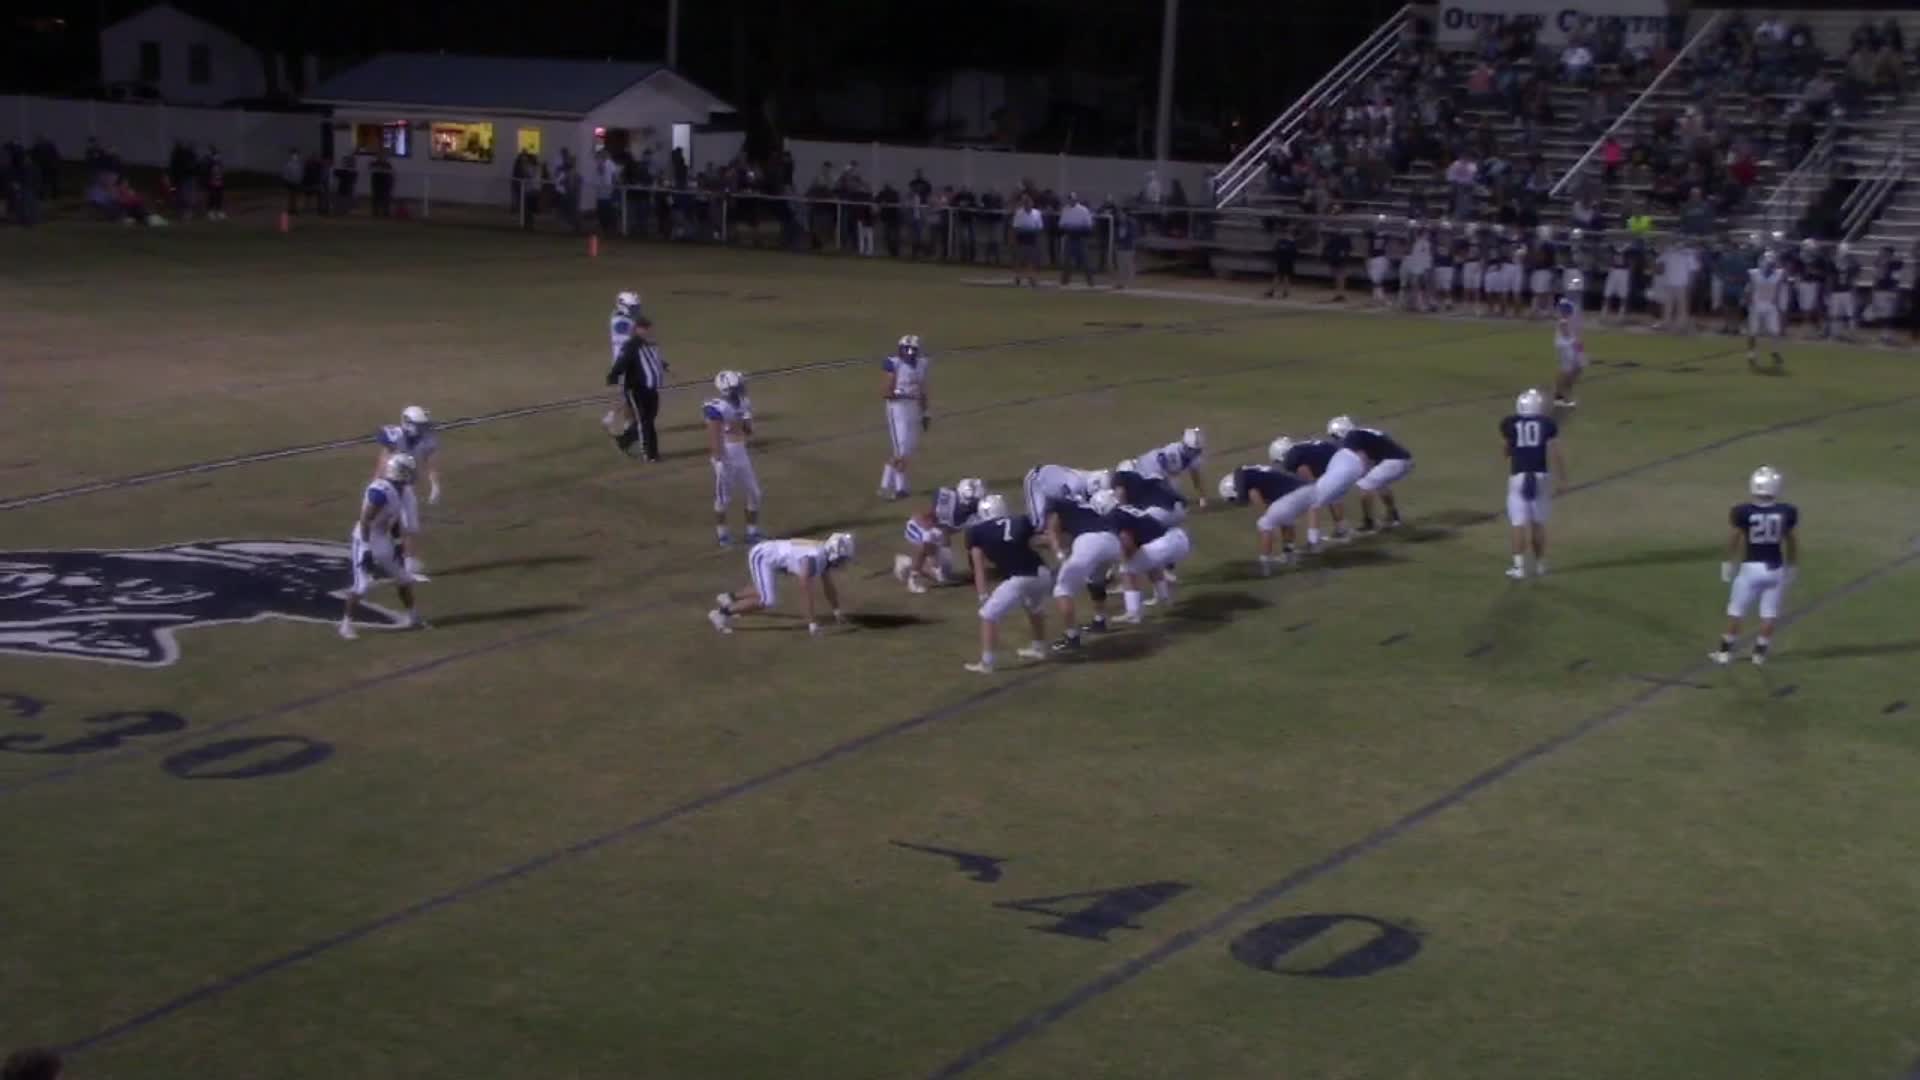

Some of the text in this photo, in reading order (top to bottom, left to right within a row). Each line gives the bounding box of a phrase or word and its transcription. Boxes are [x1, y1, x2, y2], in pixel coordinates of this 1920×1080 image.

[1557, 8, 1673, 31] COUNTR
[1515, 420, 1540, 447] 10
[995, 517, 1015, 542] 7
[1749, 513, 1781, 543] 20
